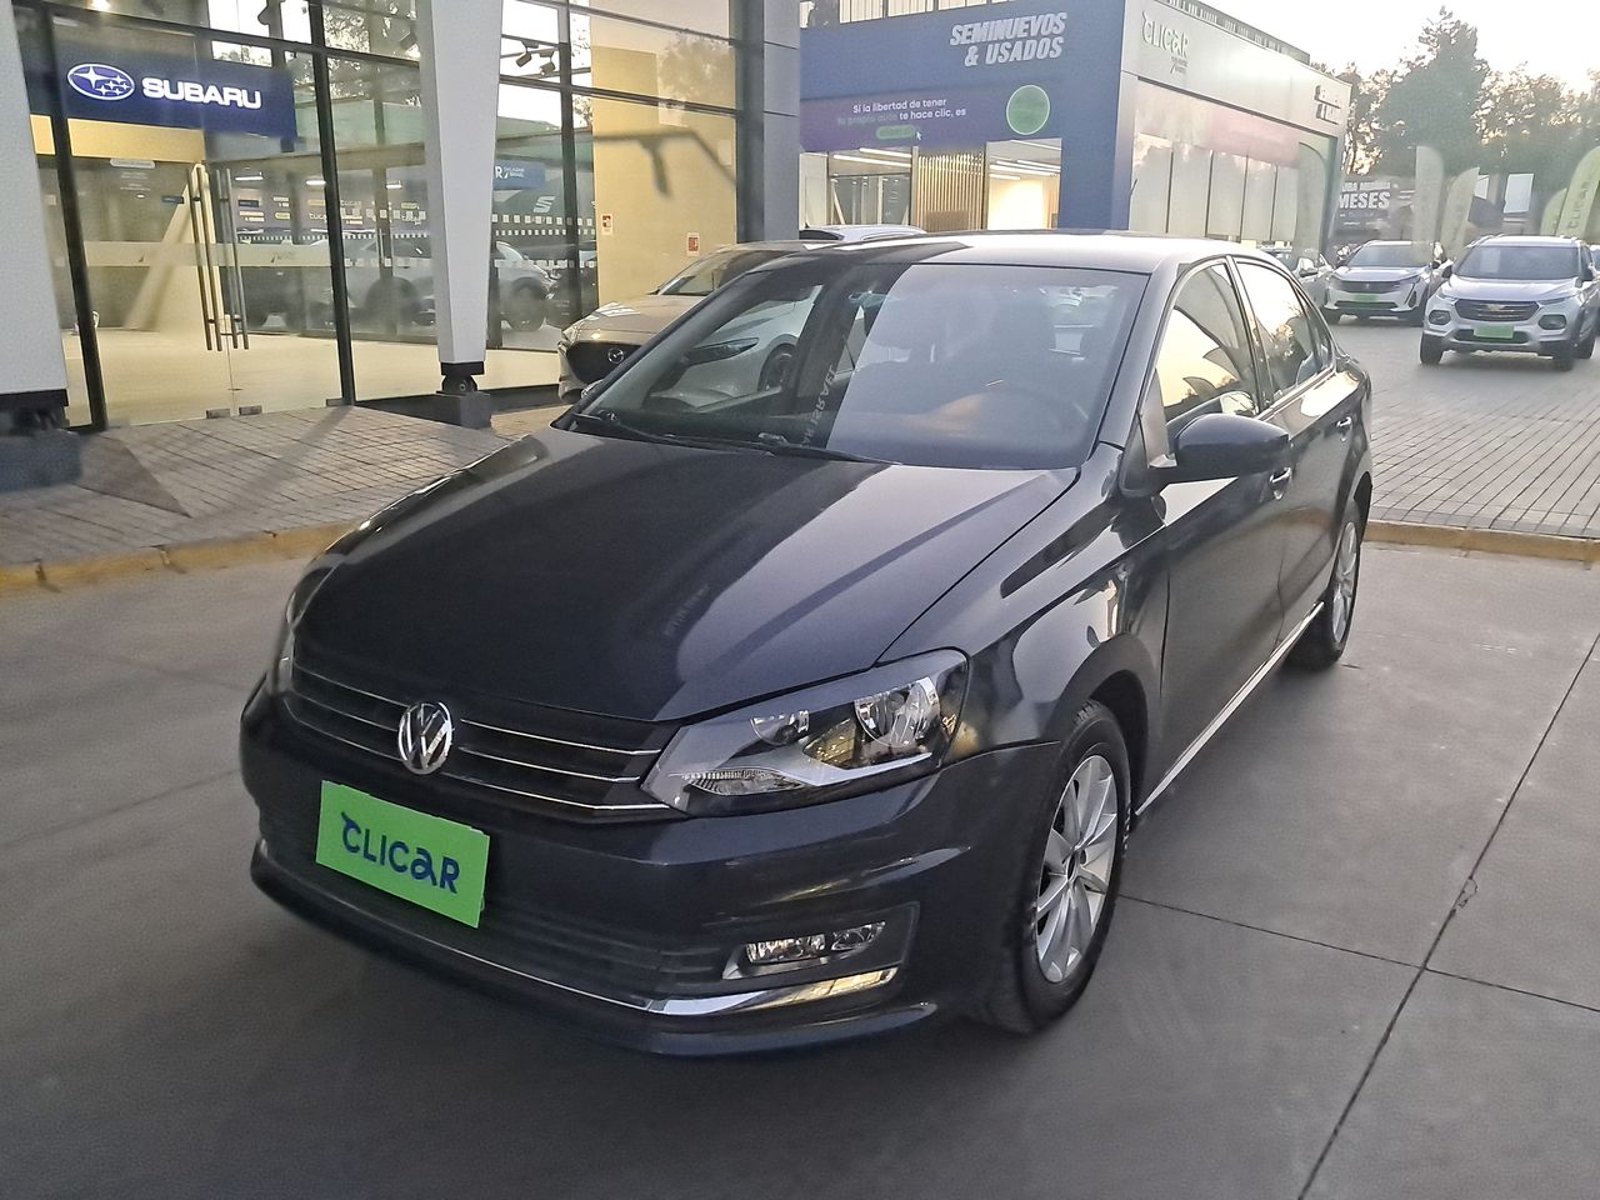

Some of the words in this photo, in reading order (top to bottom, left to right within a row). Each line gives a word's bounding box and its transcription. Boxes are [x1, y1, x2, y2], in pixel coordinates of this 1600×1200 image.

[950, 12, 1067, 45] SEMINUEVOS
[964, 45, 979, 66] &
[985, 36, 1064, 64] USADOS
[142, 77, 262, 109] SUBARU
[863, 104, 870, 112] la
[872, 100, 907, 112] libertad
[910, 100, 920, 108] de
[923, 99, 946, 107] tener
[900, 112, 909, 120] te
[911, 110, 933, 119] hace
[956, 108, 966, 116] es
[1340, 191, 1391, 209] MESES
